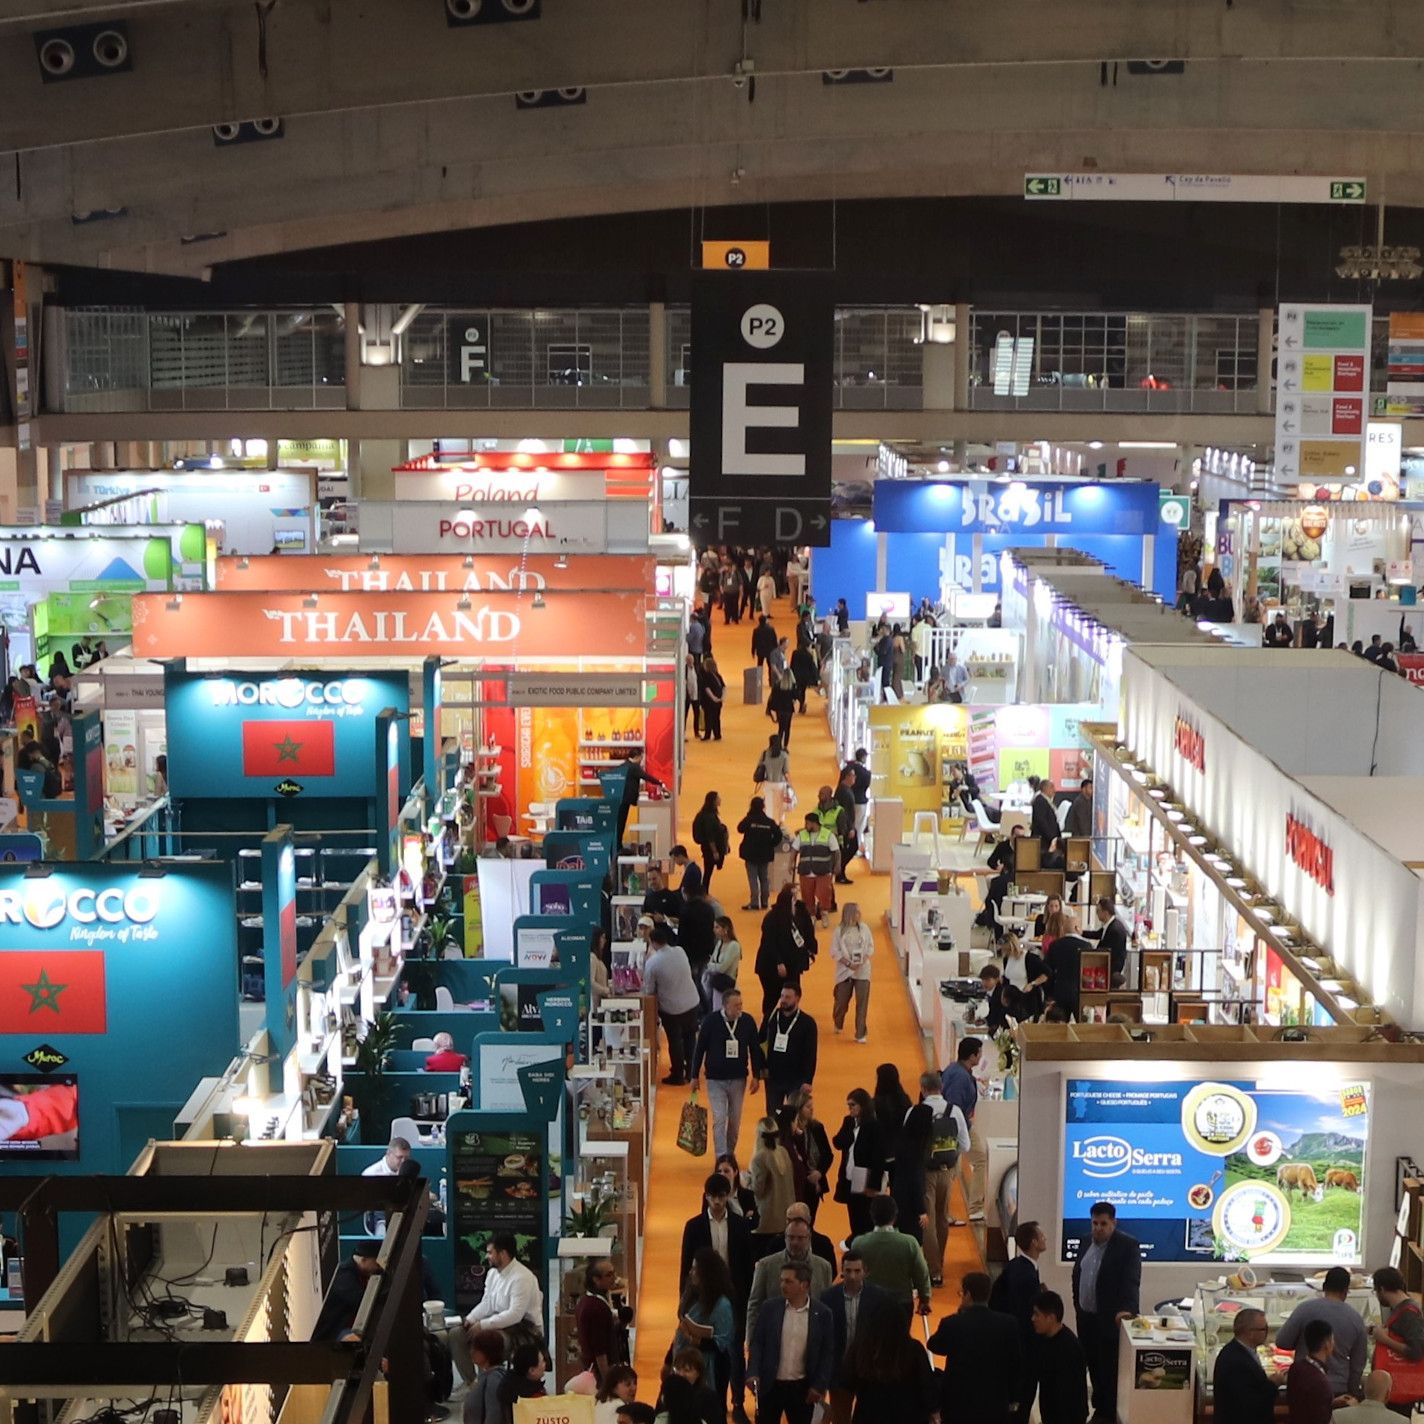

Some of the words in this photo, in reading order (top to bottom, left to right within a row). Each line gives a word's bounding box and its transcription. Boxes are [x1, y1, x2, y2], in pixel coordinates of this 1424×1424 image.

[747, 316, 778, 340] P2
[461, 346, 487, 381] F
[721, 363, 805, 475] E
[455, 483, 540, 502] Poland
[439, 520, 556, 540] PORTUGAL
[718, 508, 739, 539] F
[777, 508, 802, 540] D
[339, 569, 546, 591] THAILAND
[278, 607, 521, 643] THAILAND
[213, 680, 369, 706] MOROCCO
[527, 687, 545, 696] EXOTIC
[547, 687, 564, 696] FOOD
[566, 687, 585, 696] PUBLIC
[586, 687, 613, 696] COMPANY
[614, 687, 638, 696] LIMITED
[70, 926, 114, 946] Kingdom
[116, 926, 129, 944] of
[129, 925, 159, 942] Taste
[1343, 1104, 1367, 1117] 2024
[1072, 1141, 1125, 1159] Lacto
[1132, 1149, 1183, 1166] Serra
